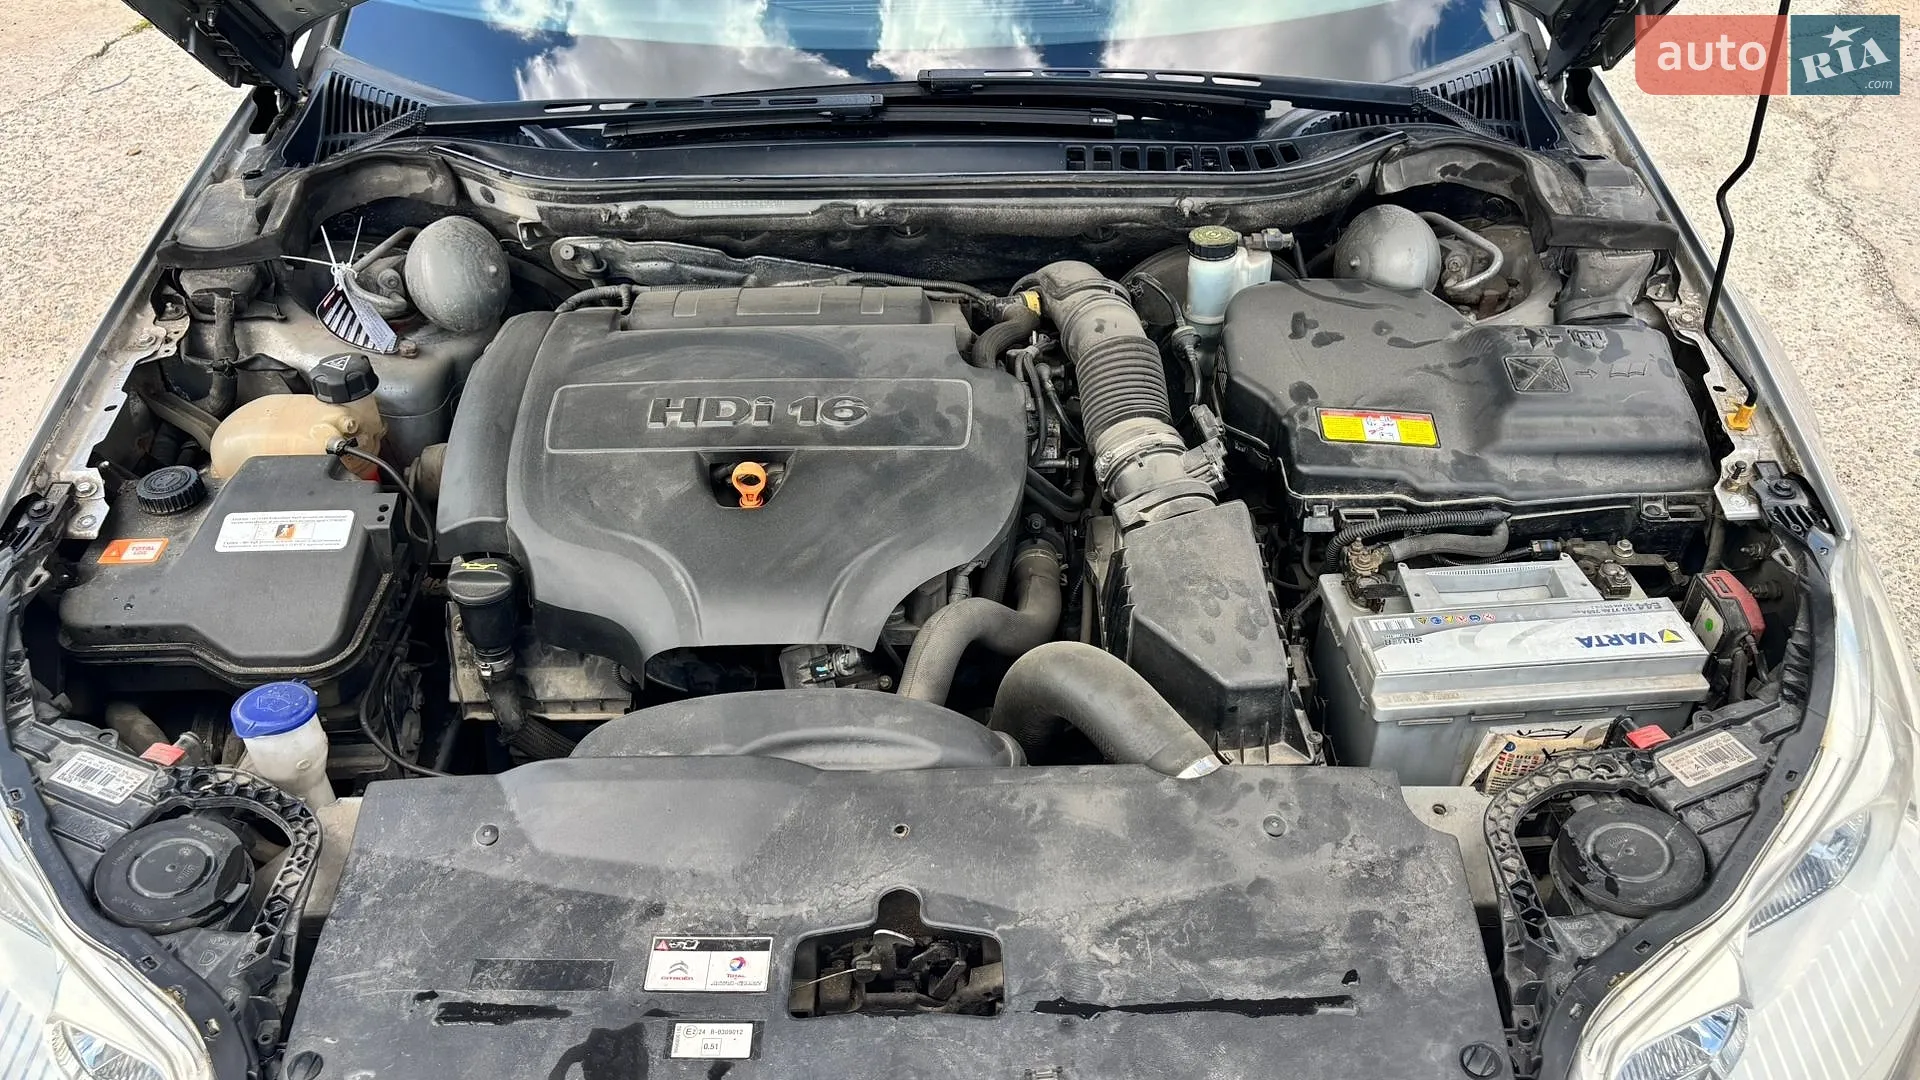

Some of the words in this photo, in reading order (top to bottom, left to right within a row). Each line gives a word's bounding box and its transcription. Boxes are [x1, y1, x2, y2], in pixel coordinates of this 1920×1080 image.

[647, 395, 775, 429] HDi
[787, 395, 872, 428] 16
[1575, 630, 1657, 648] VARTA
